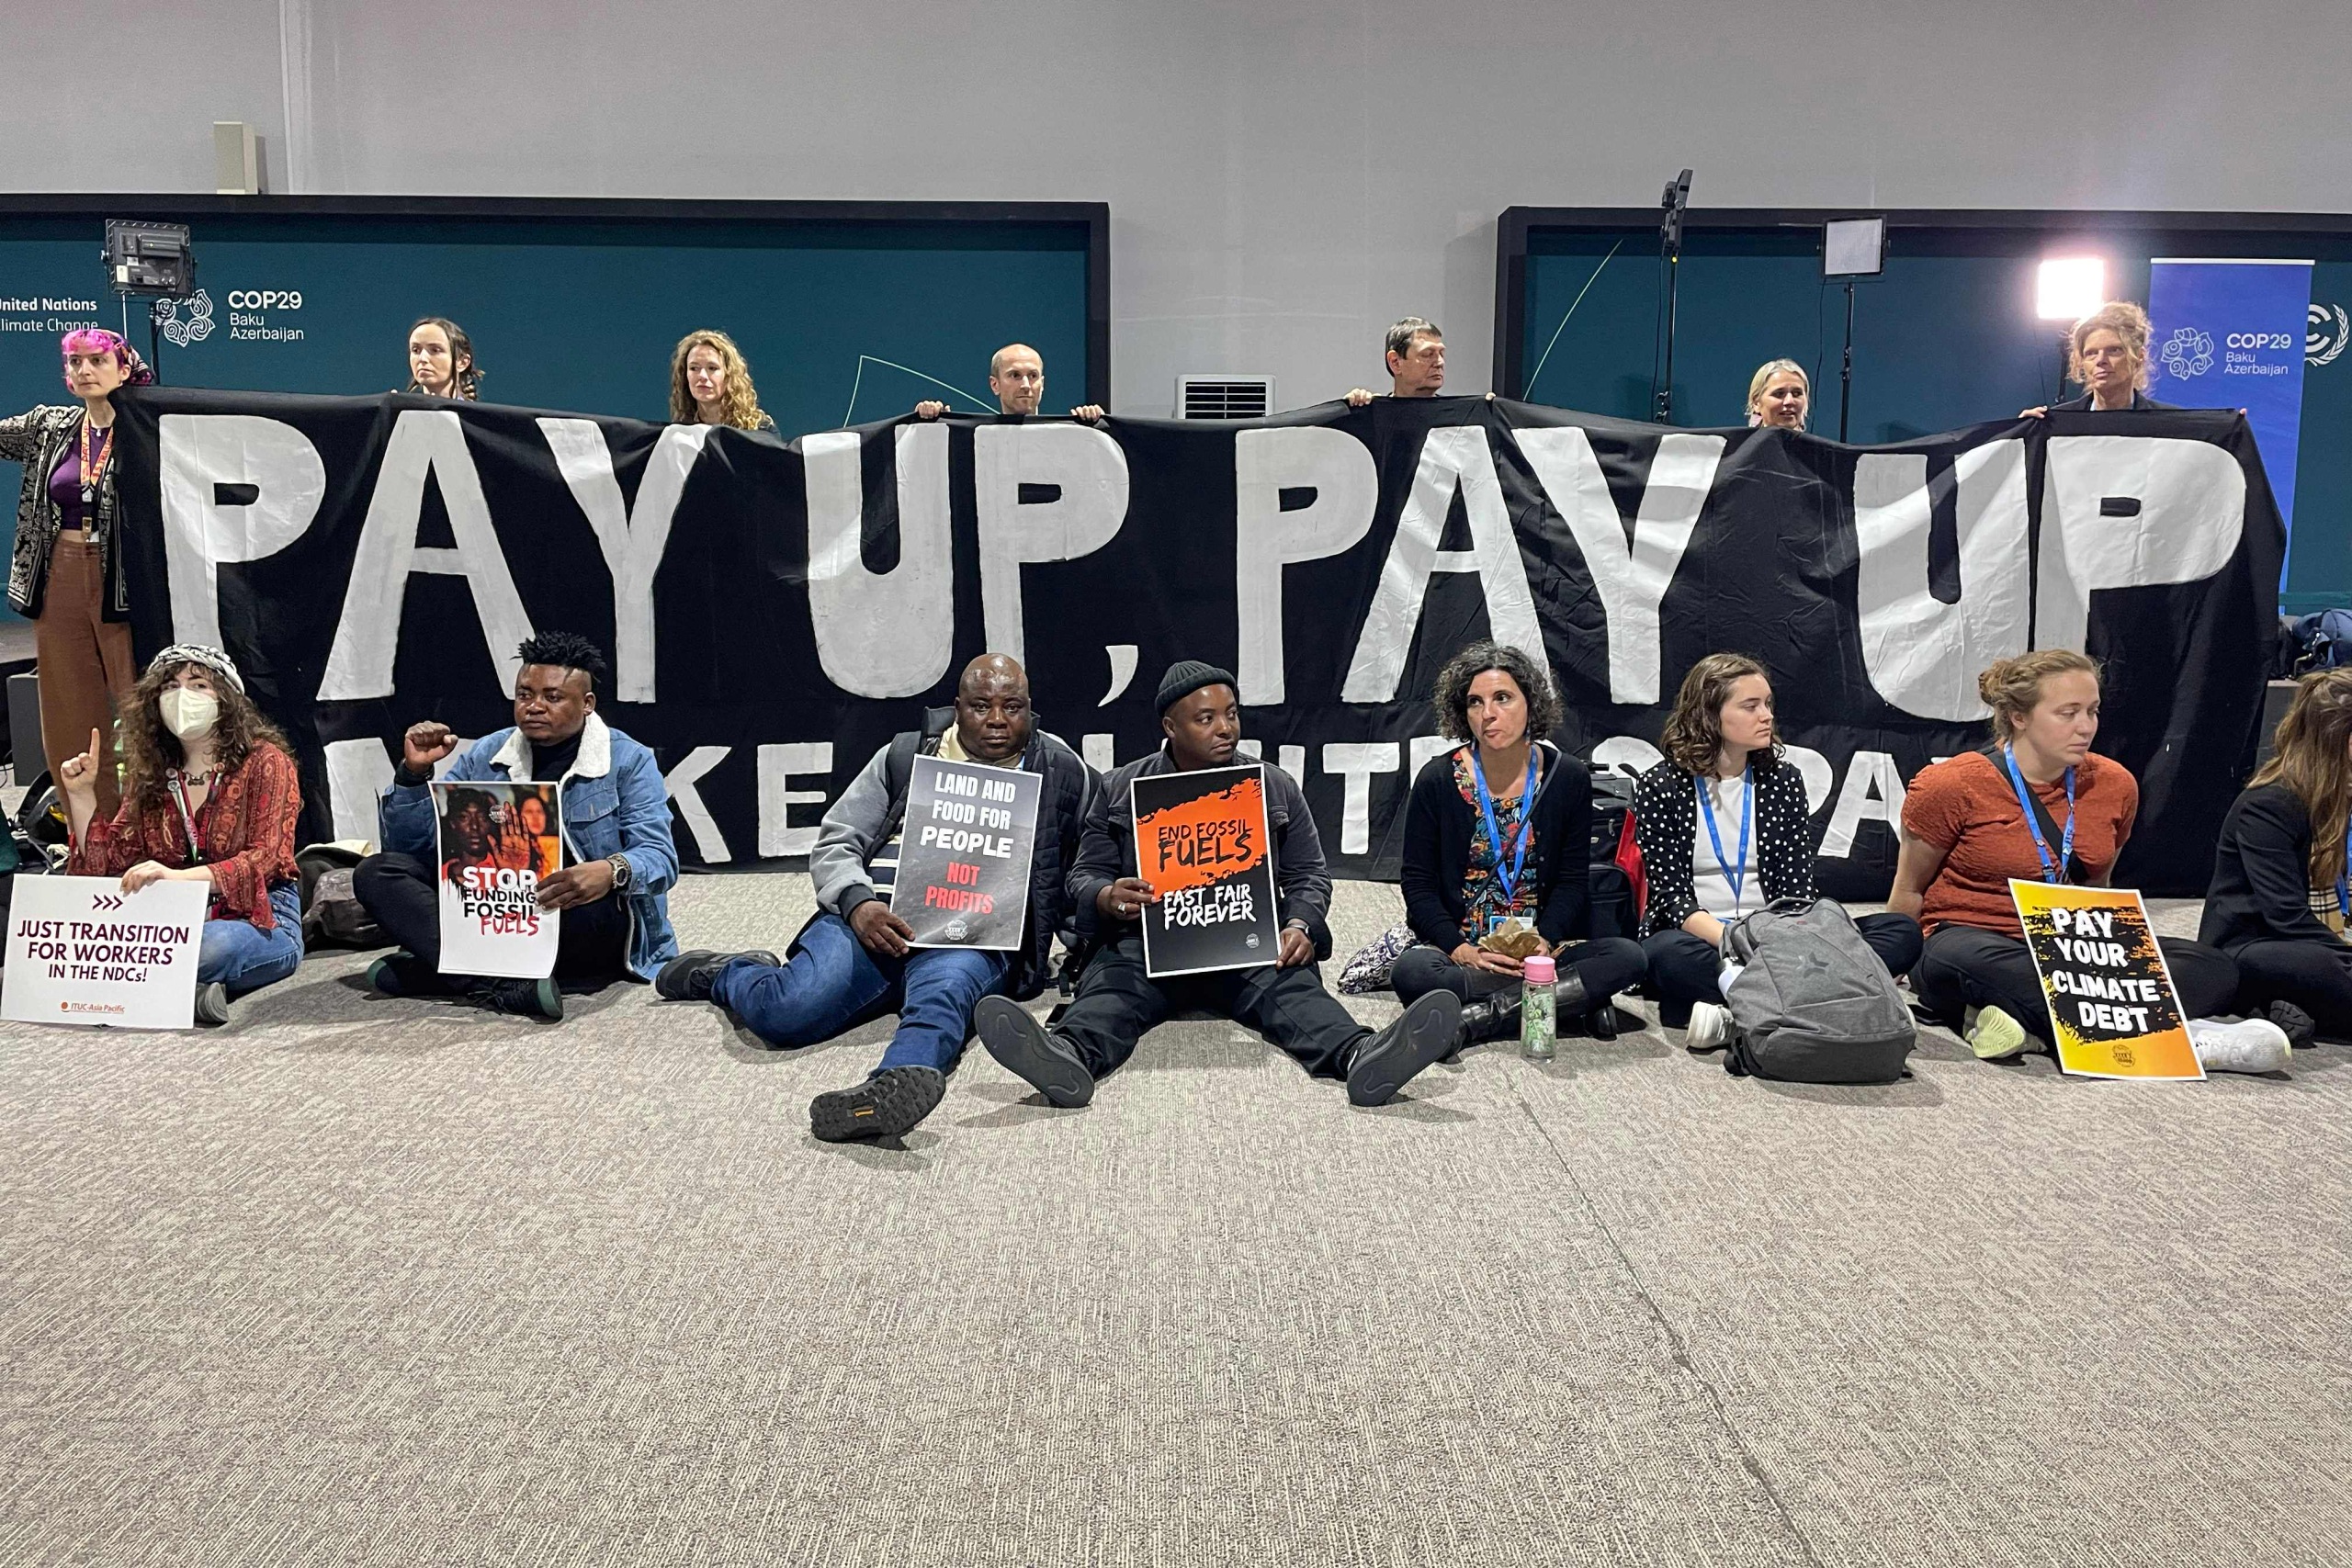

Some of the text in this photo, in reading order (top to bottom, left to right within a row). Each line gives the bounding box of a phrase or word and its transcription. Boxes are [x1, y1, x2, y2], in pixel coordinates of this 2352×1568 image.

[42, 297, 97, 311] Nations
[228, 290, 303, 310] COP29
[0, 318, 44, 332] limate
[230, 312, 265, 326] Baku
[230, 326, 305, 342] Azerbaijan
[2226, 333, 2292, 350] COP29
[2225, 351, 2256, 363] Baku
[2223, 363, 2289, 377] Azerbaijan
[159, 410, 713, 704] PAY
[1235, 424, 1727, 705] PAY
[1853, 435, 2247, 723] UP
[934, 772, 1017, 803] LAND AND
[932, 799, 1011, 830] FOOD FOR
[920, 826, 1014, 859] PEOPLE
[1159, 818, 1254, 842] END FOSSIL
[1158, 833, 1252, 873] FUELS
[462, 865, 538, 891] STOP
[945, 862, 980, 886] NOT
[463, 889, 537, 904] FUNDING
[924, 886, 994, 915] PROFITS
[1163, 883, 1253, 909] FAST FAIR
[481, 912, 540, 937] FUELS
[1163, 899, 1257, 931] FOREVER
[2051, 908, 2113, 938] PAY
[17, 919, 189, 944] JUST TRANSITION
[28, 942, 174, 965] FOR WORKERS
[2052, 937, 2129, 968] YOUR
[48, 964, 148, 983] IN THE NDCs!
[2052, 970, 2161, 1002] CLIMATE
[71, 1002, 103, 1011] ITUC-Asia
[103, 1004, 126, 1013] Pacific
[2077, 1001, 2149, 1032] DEBT
